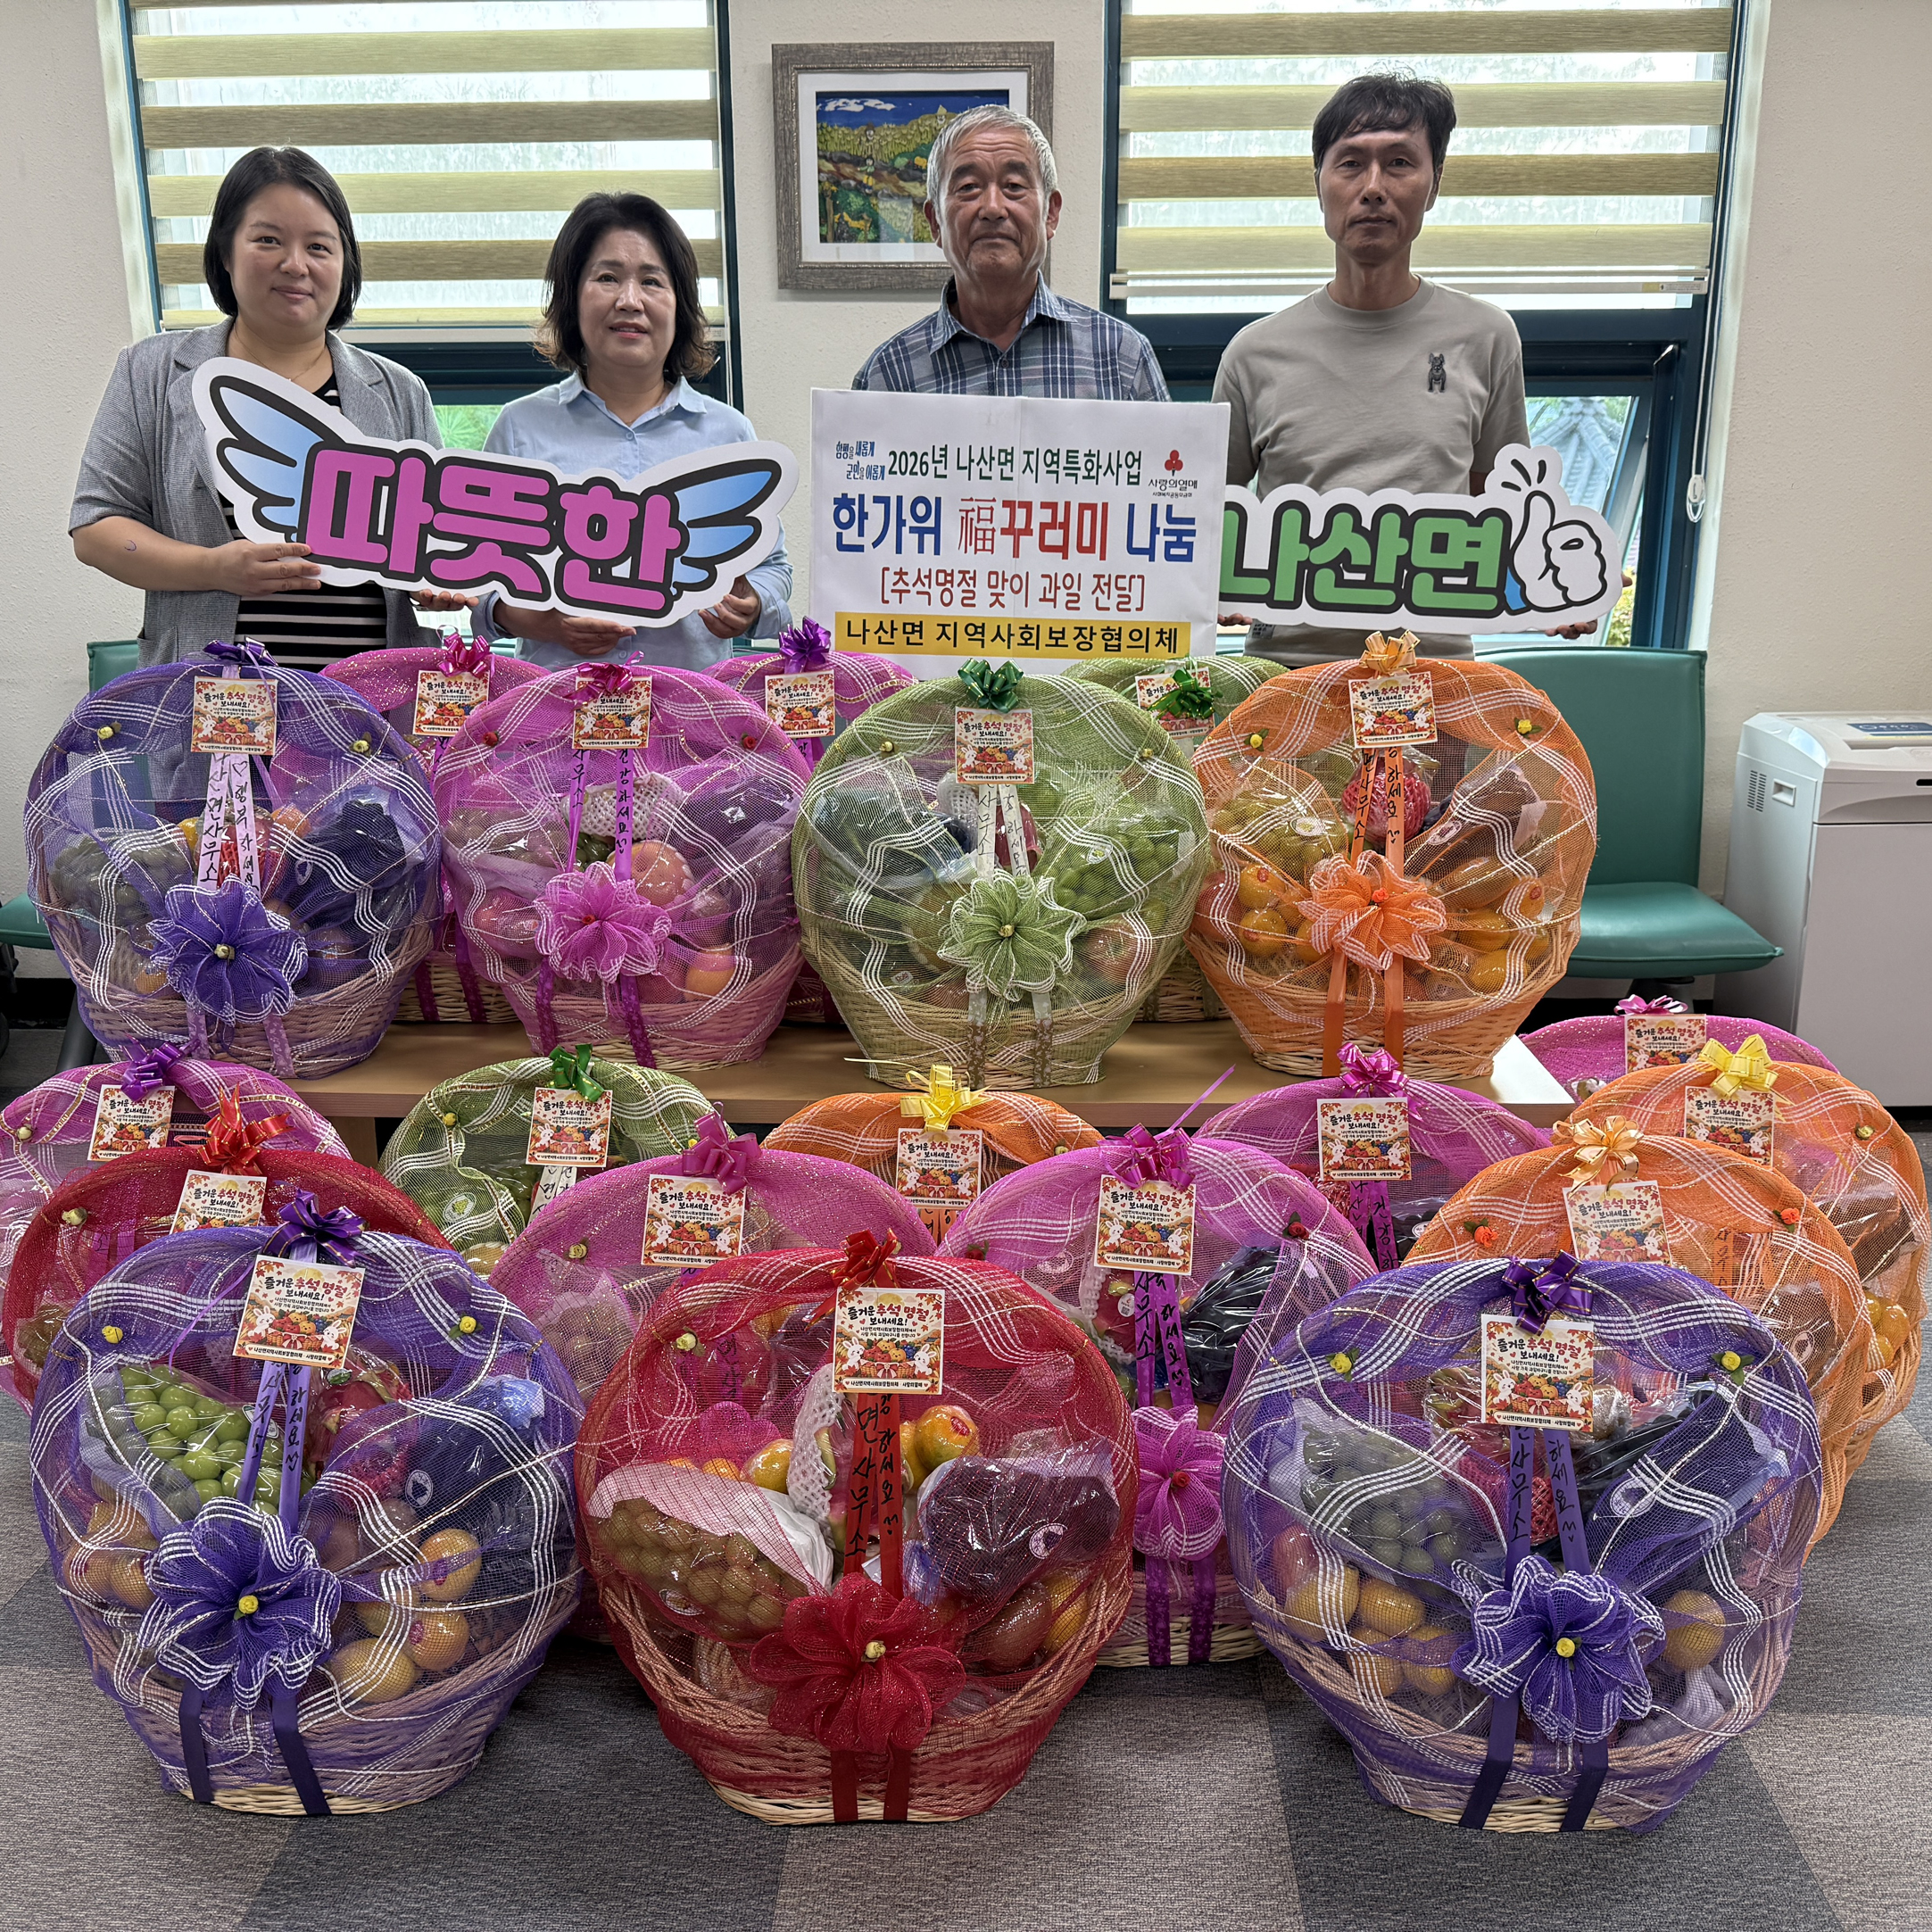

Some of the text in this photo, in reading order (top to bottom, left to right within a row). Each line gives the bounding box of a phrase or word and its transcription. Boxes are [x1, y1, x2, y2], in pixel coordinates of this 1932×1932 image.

[855, 441, 875, 457] 새롭게
[888, 444, 1142, 486] 2026년 나산면 지역특화사업
[1148, 479, 1198, 492] 사랑의열매
[303, 446, 683, 612] 따뜻한
[833, 493, 1197, 562] 한가위 福꾸러미 나눔
[1220, 507, 1504, 610] 나산면
[881, 566, 1145, 612] [추석명절 맞이 과일 전달]
[847, 618, 1178, 654] 나산면 지역사회보장협의체
[427, 680, 480, 692] 즐거운 추석 명절
[774, 683, 826, 697] 즐거운 추석 명절
[1146, 685, 1165, 697] 즐거운
[1359, 684, 1422, 701] 즐거운 추석 명절
[203, 691, 267, 706] 즐거운 추석 명절
[963, 720, 1023, 734] 즐거운 추석 명절
[200, 752, 230, 882] 나산면사무소
[978, 784, 998, 855] 사무소
[1003, 784, 1024, 869] 강하세요
[1635, 1026, 1696, 1039] 즐거운 추석 명절
[110, 1099, 129, 1110] 즐거운
[147, 1100, 165, 1112] 명절
[543, 1099, 603, 1114] 즐거운 추석 명절
[1695, 1099, 1762, 1115] 즐거운 추석 명절
[1330, 1111, 1397, 1126] 즐거운 추석 명절
[1348, 1122, 1380, 1130] 보내세요!
[908, 1141, 970, 1156] 즐거운 추석 명절
[194, 1188, 256, 1206] 즐거운 추석 명절
[209, 1198, 239, 1208] 보내세요!
[659, 1190, 733, 1208] 즐거운 추석 명절
[1110, 1190, 1182, 1209] 즐거운 추석 명절
[678, 1202, 713, 1211] 보내세요!
[1130, 1201, 1163, 1211] 보내세요!
[1578, 1197, 1648, 1216] 즐거운 추석 명절
[1599, 1209, 1631, 1219] 보내세요!
[264, 1276, 348, 1299] 즐거운 추석 명절
[285, 1289, 325, 1300] 보내세요!
[848, 1303, 929, 1323] 즐거운 추석 명절
[870, 1317, 908, 1326] 보내세요!
[1497, 1337, 1581, 1359] 즐거운 추석 명절
[1521, 1350, 1559, 1362] 보내세요!
[252, 1363, 282, 1459] 사무소
